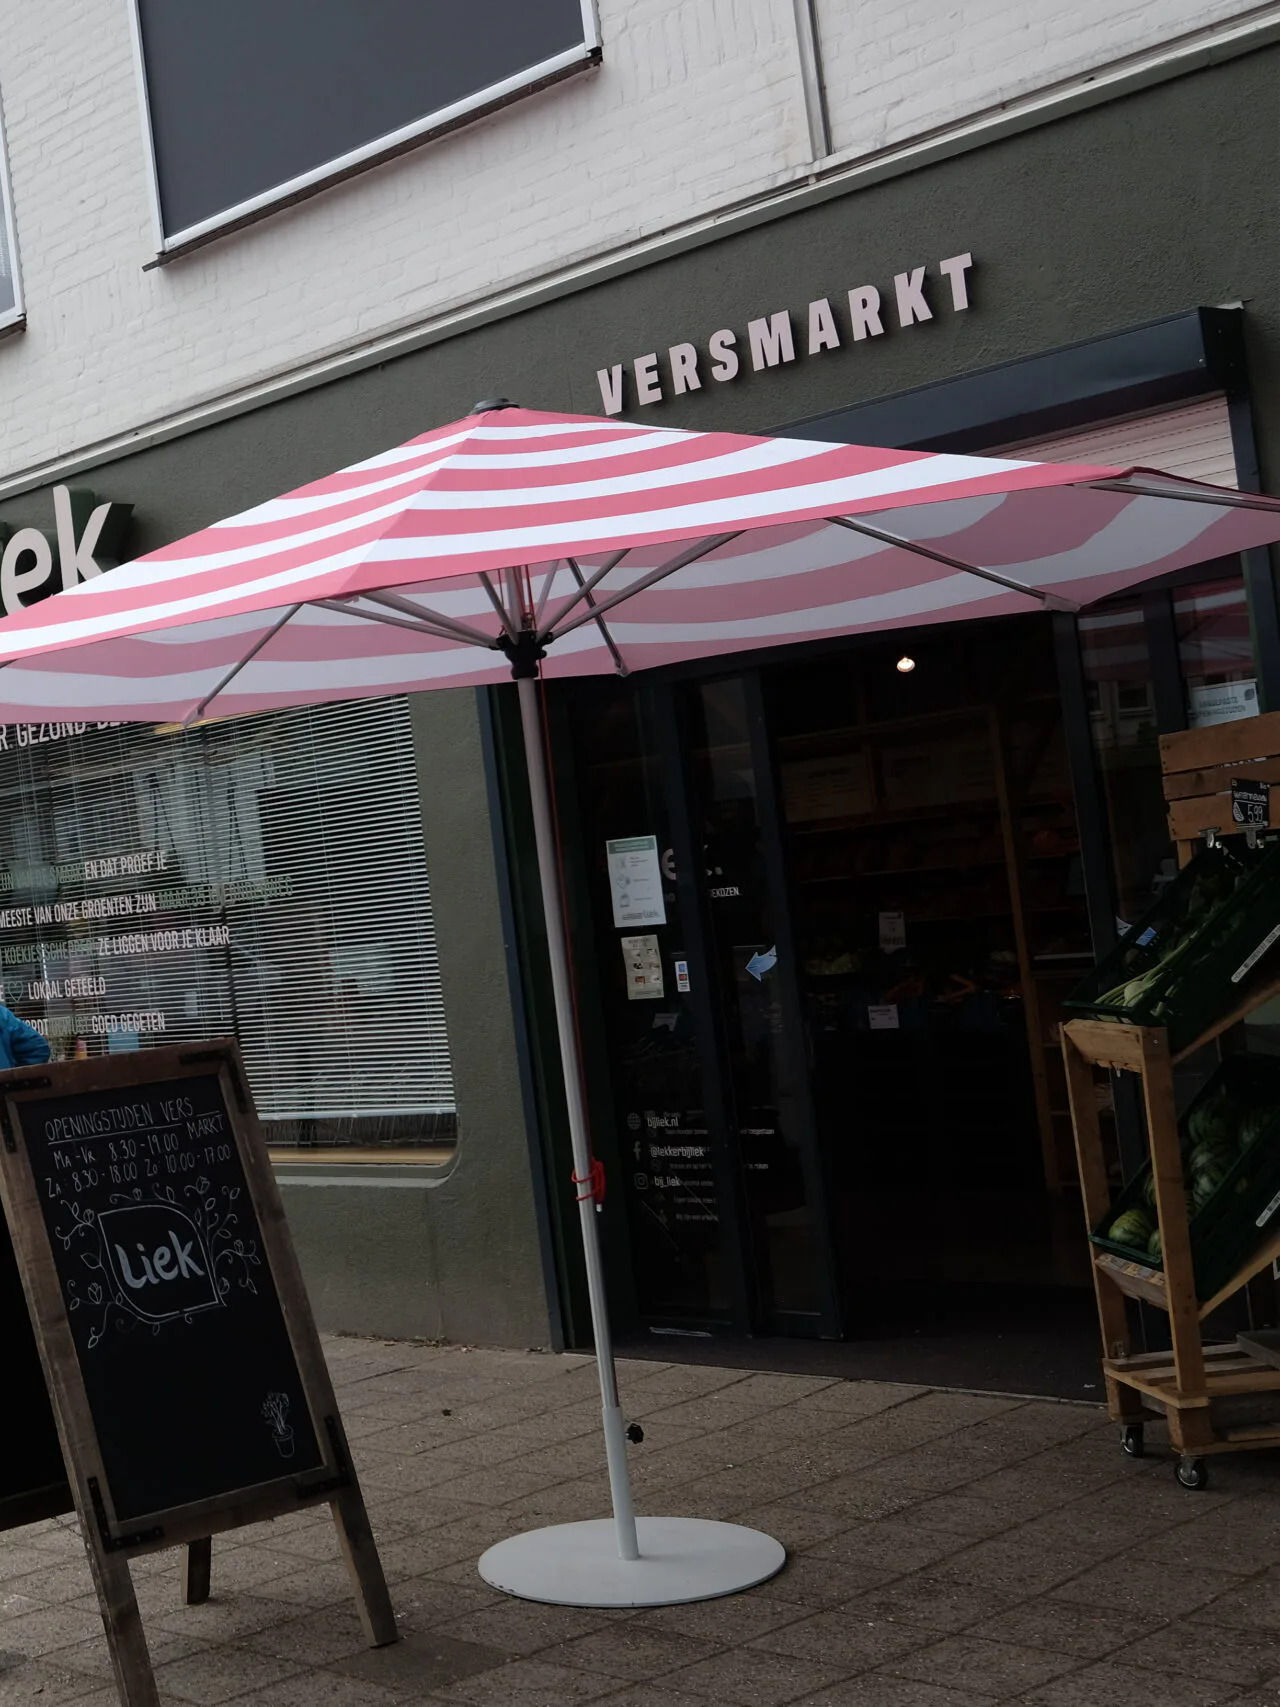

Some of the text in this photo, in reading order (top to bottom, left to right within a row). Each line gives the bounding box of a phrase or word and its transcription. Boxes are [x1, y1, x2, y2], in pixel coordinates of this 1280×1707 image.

[596, 252, 973, 417] VERSMARKT
[85, 861, 97, 879] EN
[100, 857, 117, 877] DAT
[120, 852, 153, 875] PROEF
[155, 851, 168, 871] JE
[33, 905, 52, 925] VAN
[53, 902, 79, 922] ONZE
[81, 896, 132, 919] GROENTEN
[134, 892, 157, 914] ZIJN
[98, 938, 110, 956] ZE
[112, 934, 148, 955] LIGGEN
[151, 931, 179, 951] VOOR
[181, 928, 194, 949] JE
[195, 925, 231, 947] KLAAR
[27, 980, 63, 1000] LOKAAL
[64, 977, 106, 998] GETEELD
[91, 1014, 117, 1035] GOED
[120, 1011, 166, 1033] GEGETEN
[45, 1097, 194, 1142] OPENINGSTIJDEN VERS
[186, 1114, 224, 1140] MARKT
[109, 1162, 138, 1184] 18.00
